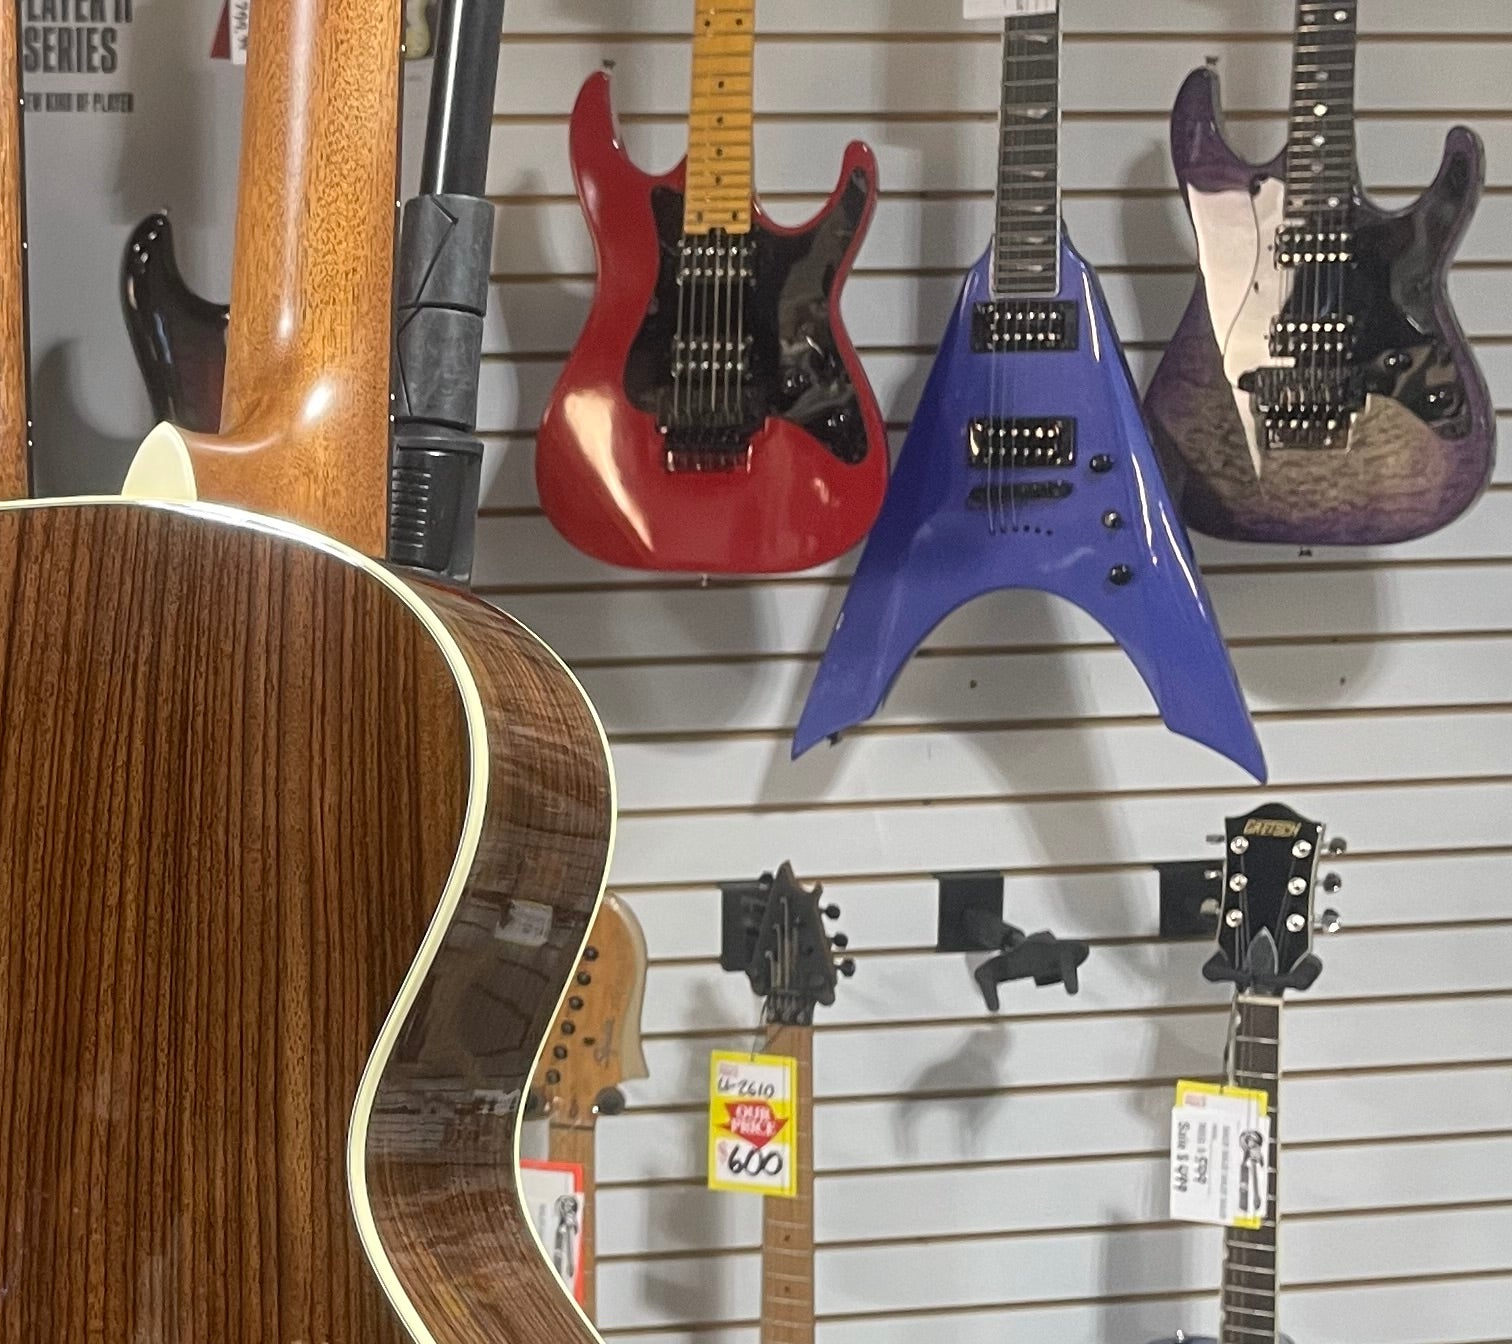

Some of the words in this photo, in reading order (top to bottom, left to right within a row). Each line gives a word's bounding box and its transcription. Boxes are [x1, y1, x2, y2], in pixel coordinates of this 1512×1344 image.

[23, 26, 118, 74] SERIES
[734, 1104, 771, 1120] OUR
[730, 1116, 778, 1137] PRICE
